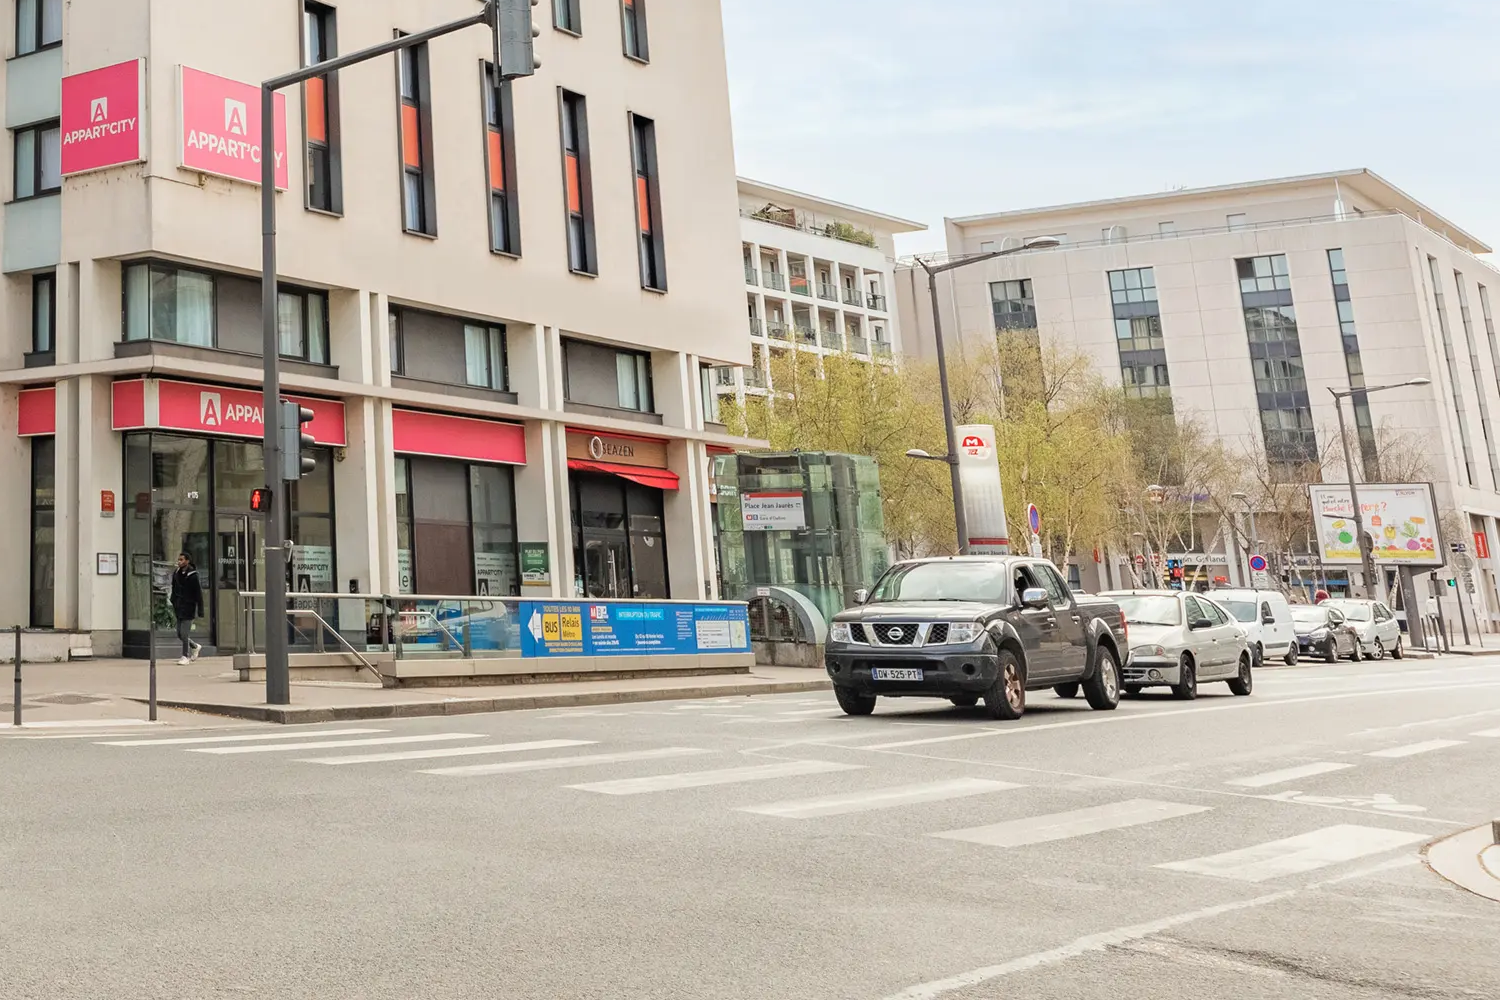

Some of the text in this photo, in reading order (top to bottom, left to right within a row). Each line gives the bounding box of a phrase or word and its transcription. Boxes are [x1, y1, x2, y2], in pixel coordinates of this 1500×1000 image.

[63, 117, 136, 146] APPART'CITY
[187, 129, 284, 169] APPART'CY
[602, 443, 634, 457] SEAZEN
[775, 501, 794, 509] Jaurès
[543, 605, 559, 613] TOUTES
[559, 605, 567, 613] LES
[544, 621, 558, 633] BUS
[561, 617, 580, 628] Relais
[562, 630, 576, 638] Métro
